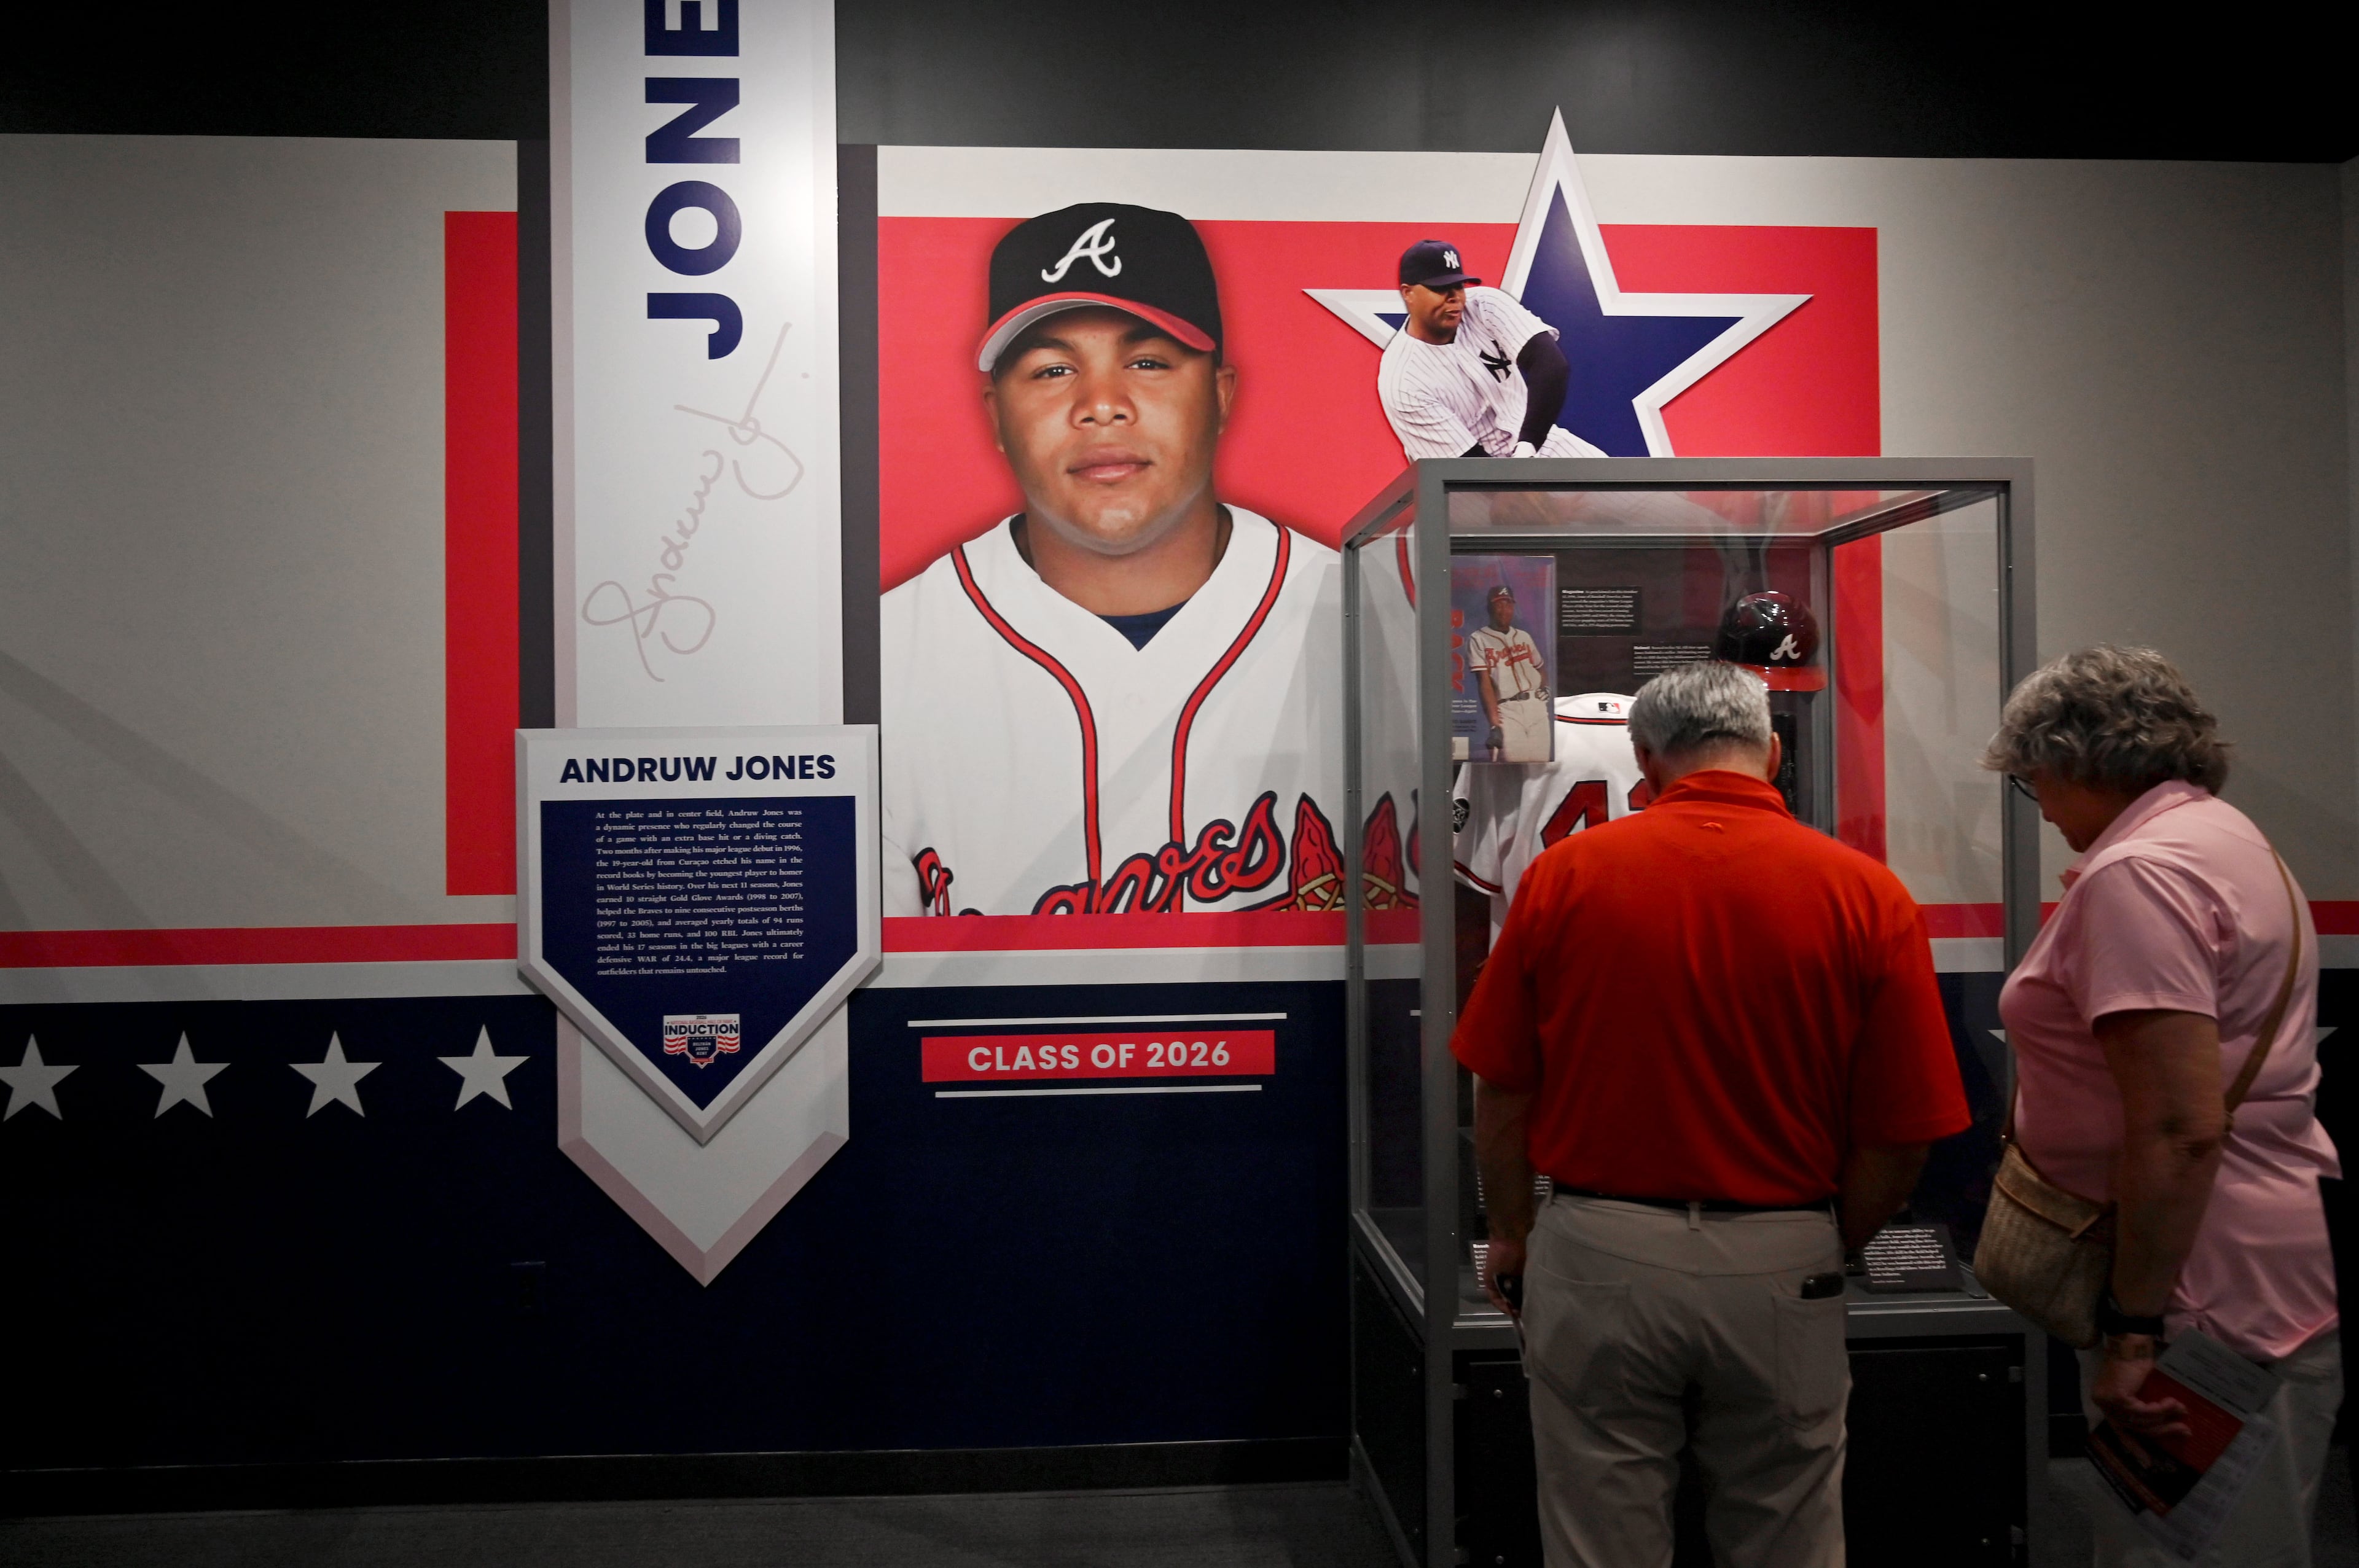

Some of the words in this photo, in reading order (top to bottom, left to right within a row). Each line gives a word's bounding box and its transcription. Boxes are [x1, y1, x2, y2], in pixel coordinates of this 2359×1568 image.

[1041, 218, 1122, 283] A
[1770, 633, 1801, 661] A
[560, 756, 718, 783] ANDRUW
[726, 754, 836, 781] JONES
[625, 811, 644, 819] plate
[603, 823, 635, 832] dynamic
[693, 822, 726, 830] regularly
[729, 821, 760, 830] changed
[753, 833, 777, 841] diving
[663, 846, 691, 855] making
[705, 846, 726, 854] major
[727, 845, 751, 854] league
[647, 871, 655, 880] by
[658, 870, 694, 879] becoming
[745, 869, 767, 878] player
[657, 883, 685, 891] history.
[638, 895, 667, 903] straight
[597, 908, 622, 916] helped
[675, 918, 708, 927] averaged
[711, 918, 734, 926] yearly
[766, 928, 804, 937] ultimately
[721, 942, 748, 950] leagues
[708, 954, 730, 962] major
[734, 953, 758, 962] league
[665, 1023, 738, 1036] INDUCTION
[968, 1045, 1080, 1072] CLASS
[1090, 1043, 1136, 1069] OF
[1146, 1041, 1230, 1067] 2026
